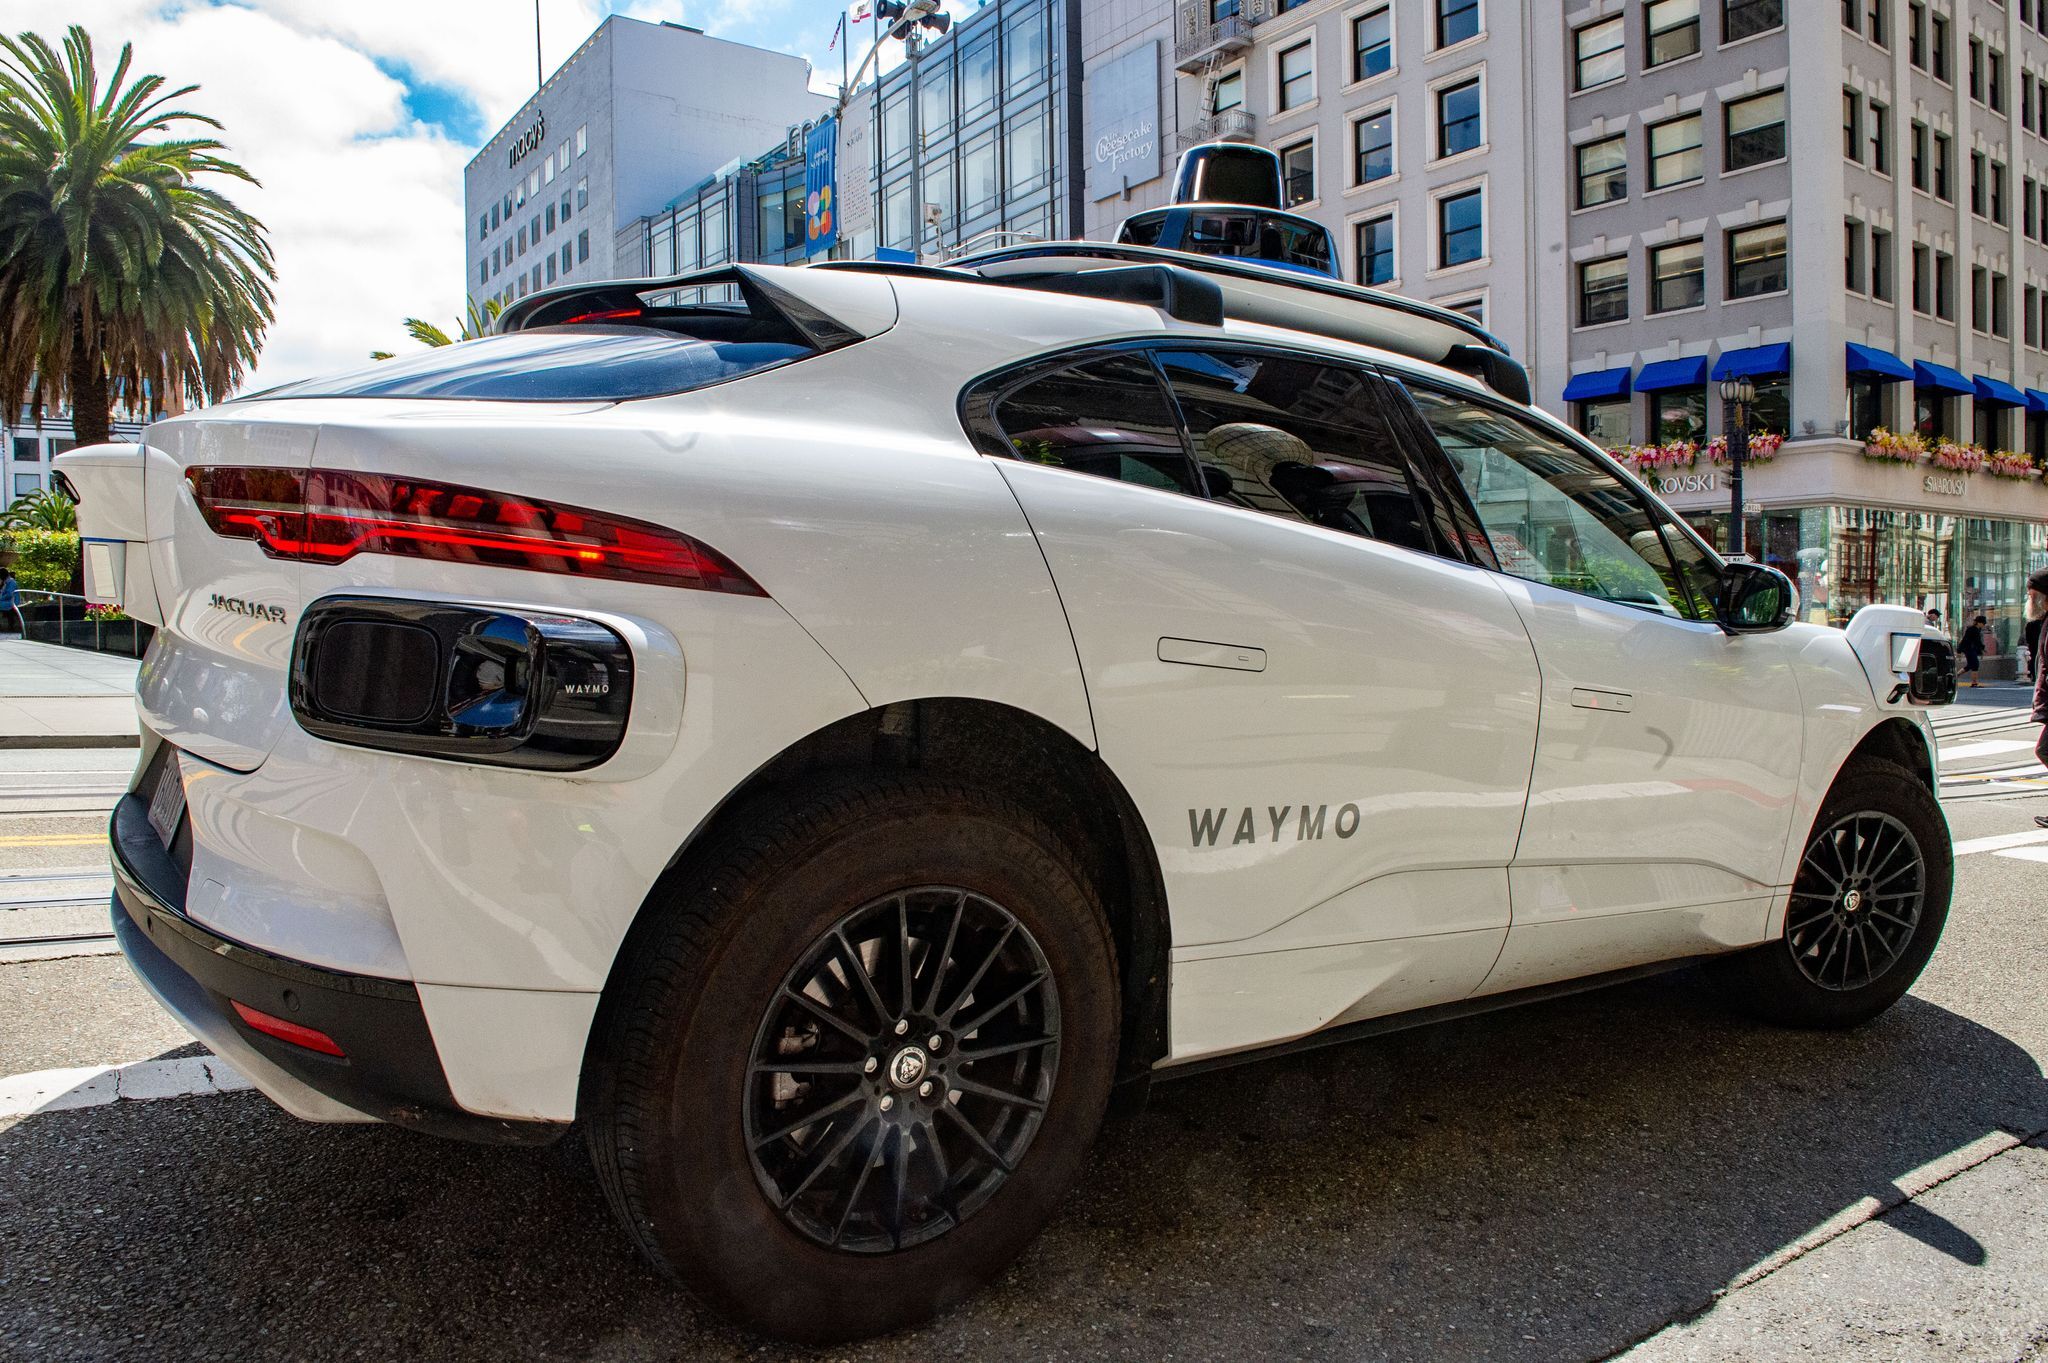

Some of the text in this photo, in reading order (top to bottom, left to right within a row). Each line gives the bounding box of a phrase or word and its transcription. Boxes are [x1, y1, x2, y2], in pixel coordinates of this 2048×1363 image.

[509, 109, 545, 169] macy's
[1095, 121, 1152, 162] Cheesecake
[1107, 141, 1153, 173] Factory
[1926, 476, 1967, 496] SWAROVSKI
[208, 594, 287, 624] JAGUAR
[565, 684, 609, 694] WAYMO
[1188, 803, 1361, 847] WAYMO
